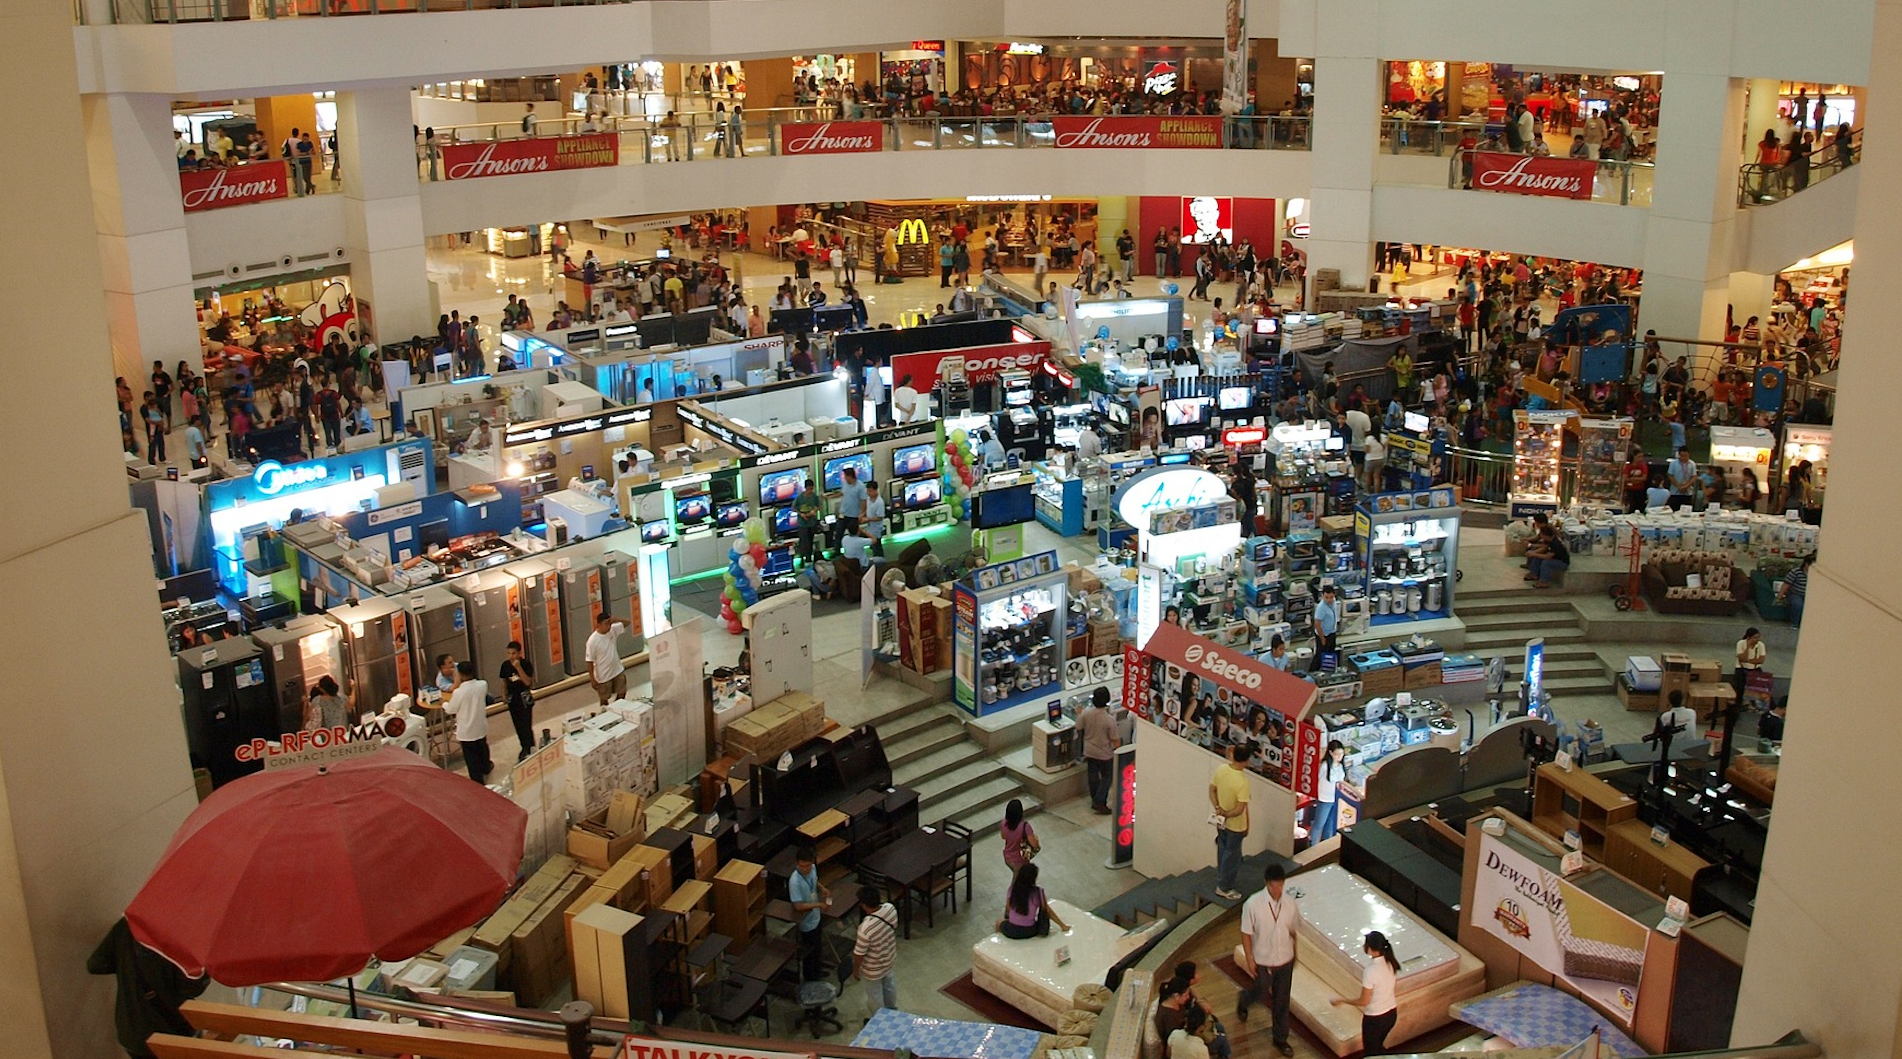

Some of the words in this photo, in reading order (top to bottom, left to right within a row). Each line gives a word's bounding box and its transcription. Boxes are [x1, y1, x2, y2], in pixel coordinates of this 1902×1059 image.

[788, 124, 872, 152] Anson's
[1057, 118, 1151, 147] Anson's
[1157, 132, 1217, 146] SHOWDOWN
[1160, 120, 1213, 132] APPLIANCE
[554, 150, 614, 167] SHOWDOWN
[557, 138, 611, 153] APPLIANCE
[449, 143, 548, 180] Anson's
[1480, 157, 1582, 192] Anson's
[184, 169, 277, 207] Anson's
[745, 340, 784, 350] SHARP
[936, 353, 1045, 374] Poneer
[1201, 651, 1262, 689] Saeco
[1127, 663, 1138, 708] Saeco
[270, 751, 325, 767] CONTACT
[330, 743, 378, 758] CENTERS
[1301, 743, 1316, 794] Saeco
[1485, 850, 1563, 910] DEWFOAM
[1507, 900, 1519, 917] 10
